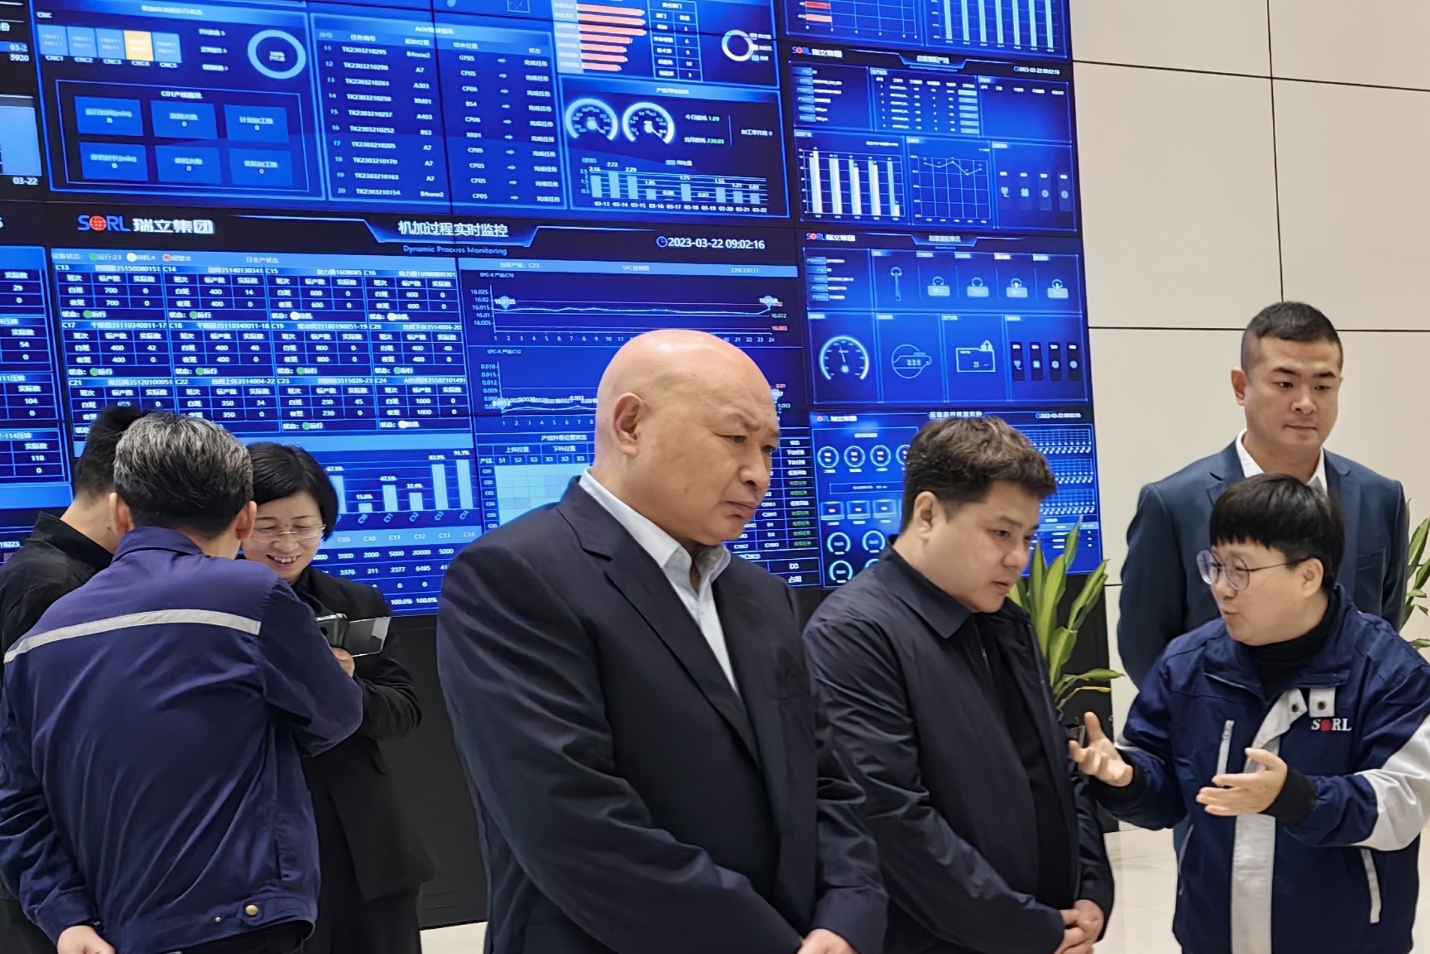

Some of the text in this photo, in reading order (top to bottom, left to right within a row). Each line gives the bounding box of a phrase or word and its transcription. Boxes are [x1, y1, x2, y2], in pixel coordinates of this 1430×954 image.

[13, 177, 38, 185] 03-22
[132, 218, 215, 234] 瑞立集团
[398, 220, 509, 238] 机加过程实时监控
[668, 238, 765, 249] 2023-03-22 09:02:16
[403, 245, 435, 253] Dynamic
[467, 247, 507, 255] Monitoring
